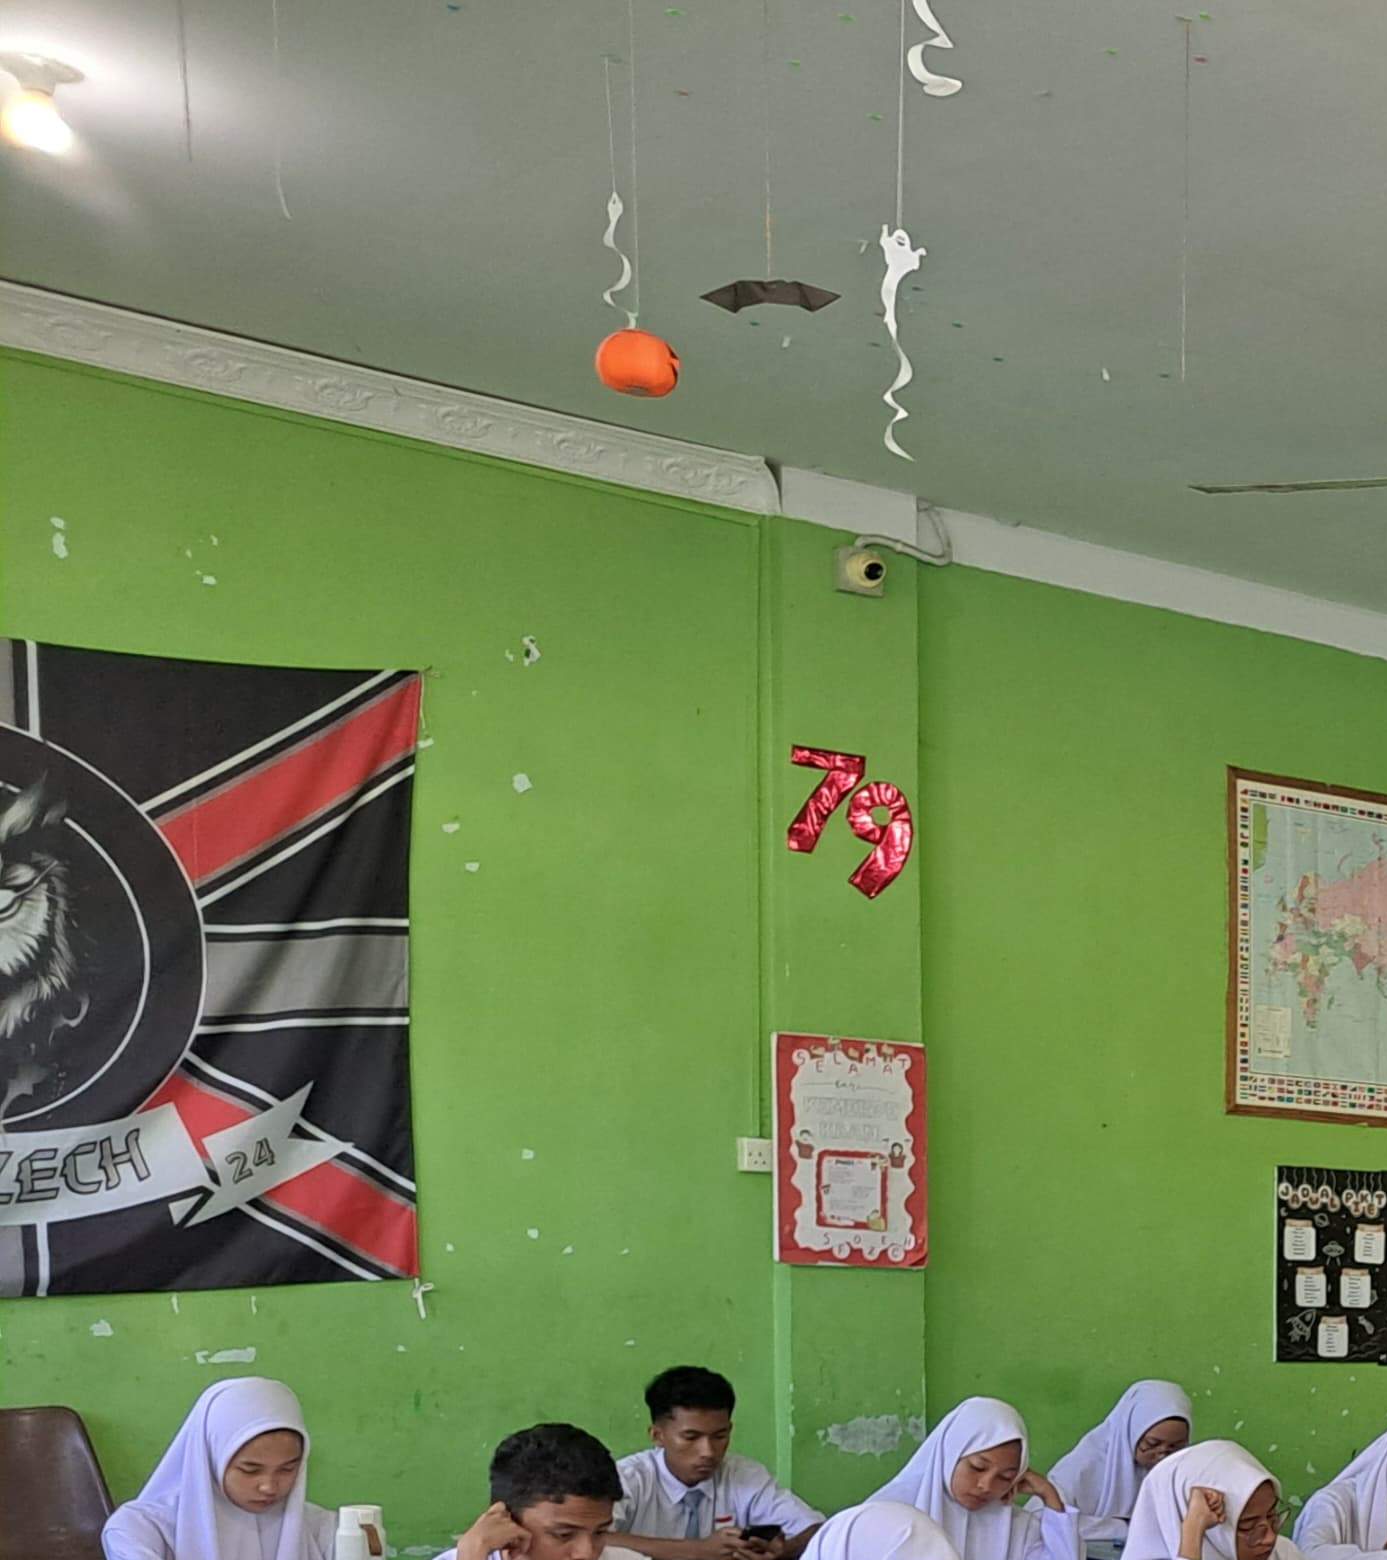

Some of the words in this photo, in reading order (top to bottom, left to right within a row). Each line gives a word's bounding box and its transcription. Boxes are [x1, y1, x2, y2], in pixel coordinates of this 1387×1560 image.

[796, 1051, 908, 1075] SELAMAT
[225, 1138, 275, 1185] 24
[1343, 1191, 1386, 1216] PIKET
